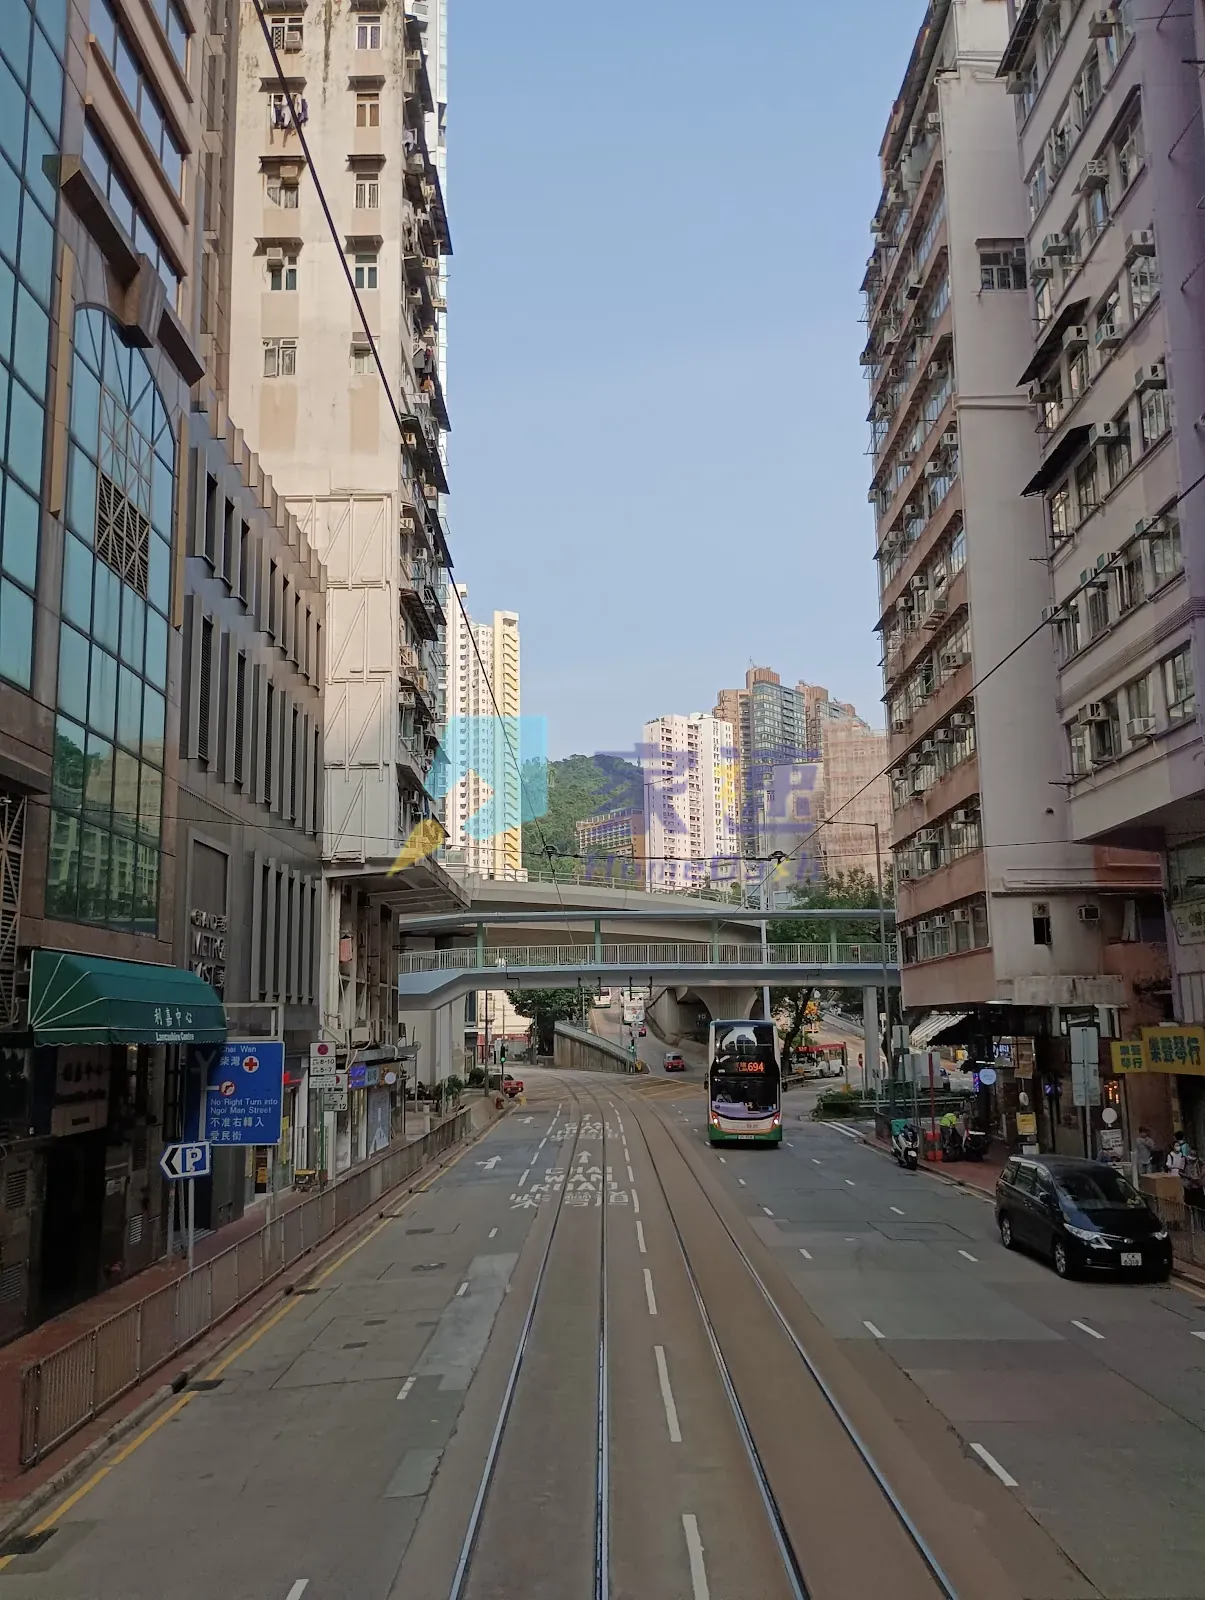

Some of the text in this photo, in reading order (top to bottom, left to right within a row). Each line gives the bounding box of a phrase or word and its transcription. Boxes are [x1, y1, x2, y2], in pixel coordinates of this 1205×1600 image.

[220, 1045, 257, 1053] Chai Wan
[219, 1055, 241, 1067] 柴灣
[747, 1062, 765, 1072] 694
[210, 1098, 221, 1106] No
[224, 1098, 243, 1107] Right
[210, 1107, 227, 1115] Ngoi
[248, 1106, 272, 1114] Street
[210, 1130, 242, 1141] 愛民街
[186, 1148, 203, 1172] P
[545, 1166, 613, 1174] CHAI
[544, 1173, 613, 1182] WAN
